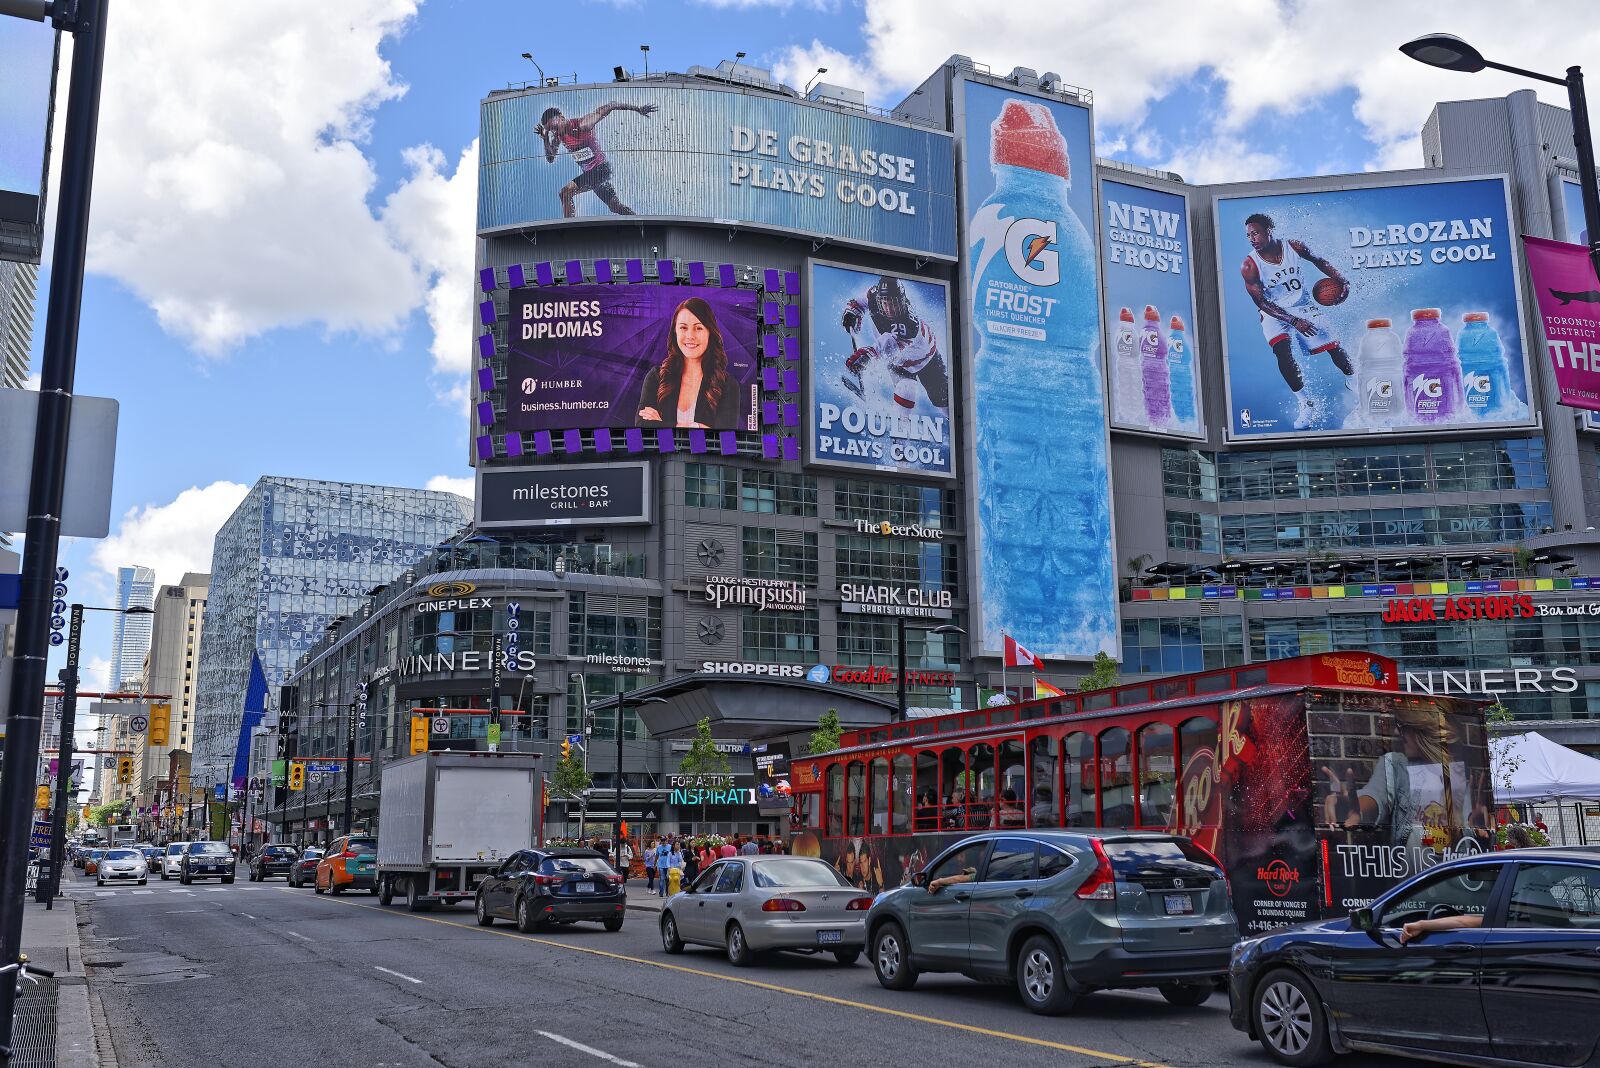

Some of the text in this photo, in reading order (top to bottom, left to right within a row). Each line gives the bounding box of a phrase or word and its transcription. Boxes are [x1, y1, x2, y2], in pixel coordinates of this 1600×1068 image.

[730, 125, 915, 184] DE GRASSE
[730, 161, 915, 215] PLAYS COOL
[1107, 200, 1180, 239] NEW
[1109, 230, 1182, 253] GATORADE
[1004, 217, 1061, 287] G
[1110, 243, 1183, 274] FROST
[1352, 244, 1496, 269] PLAYS COOL
[988, 280, 1029, 293] GATORADE
[1282, 278, 1302, 292] 10
[523, 300, 600, 320] BUSINESS
[985, 287, 1057, 318] FROST
[986, 309, 1046, 325] THIRST QUENCHER
[522, 321, 603, 340] DIPLOMAS
[890, 323, 906, 335] 29
[992, 325, 1040, 338] GLACIER FREEZE
[1549, 327, 1596, 339] DISTRICT
[541, 379, 583, 390] HUMBER
[1562, 388, 1599, 400] LIVE YONGE
[521, 401, 609, 412] business.humber.ca
[819, 403, 943, 443] POULIN
[819, 435, 945, 466] PLAYS COOL
[512, 484, 609, 500] milestones
[550, 501, 578, 510] GRILL
[1321, 523, 1360, 537] DMZ
[1385, 521, 1424, 535] DMZ
[1450, 519, 1492, 533] DMZ
[706, 575, 790, 588] LOUNGE RESTAURANT
[841, 583, 952, 608] SHARK CLUB
[418, 598, 492, 613] CINEPLEX
[861, 604, 936, 617] SPORTS BAR GRILL
[1383, 597, 1437, 623] JACK
[1444, 594, 1535, 621] ASTOR'S
[1538, 604, 1563, 616] Bar
[1567, 604, 1586, 615] and
[69, 609, 80, 666] DOWNTOWN
[586, 652, 651, 667] milestones
[702, 662, 804, 678] SHOPPERS
[833, 665, 954, 687] GoodLife ITNESS
[1336, 667, 1376, 687] Toronto
[716, 744, 744, 753] ULTRA
[671, 776, 694, 787] FOR
[1337, 844, 1437, 879] THIS IS
[1257, 867, 1299, 883] Hard Rock
[1253, 899, 1308, 909] CORNER OF YONGE ST
[1418, 901, 1426, 909] ST
[1263, 909, 1285, 917] DUNDAS
[1285, 910, 1306, 919] SQUARE
